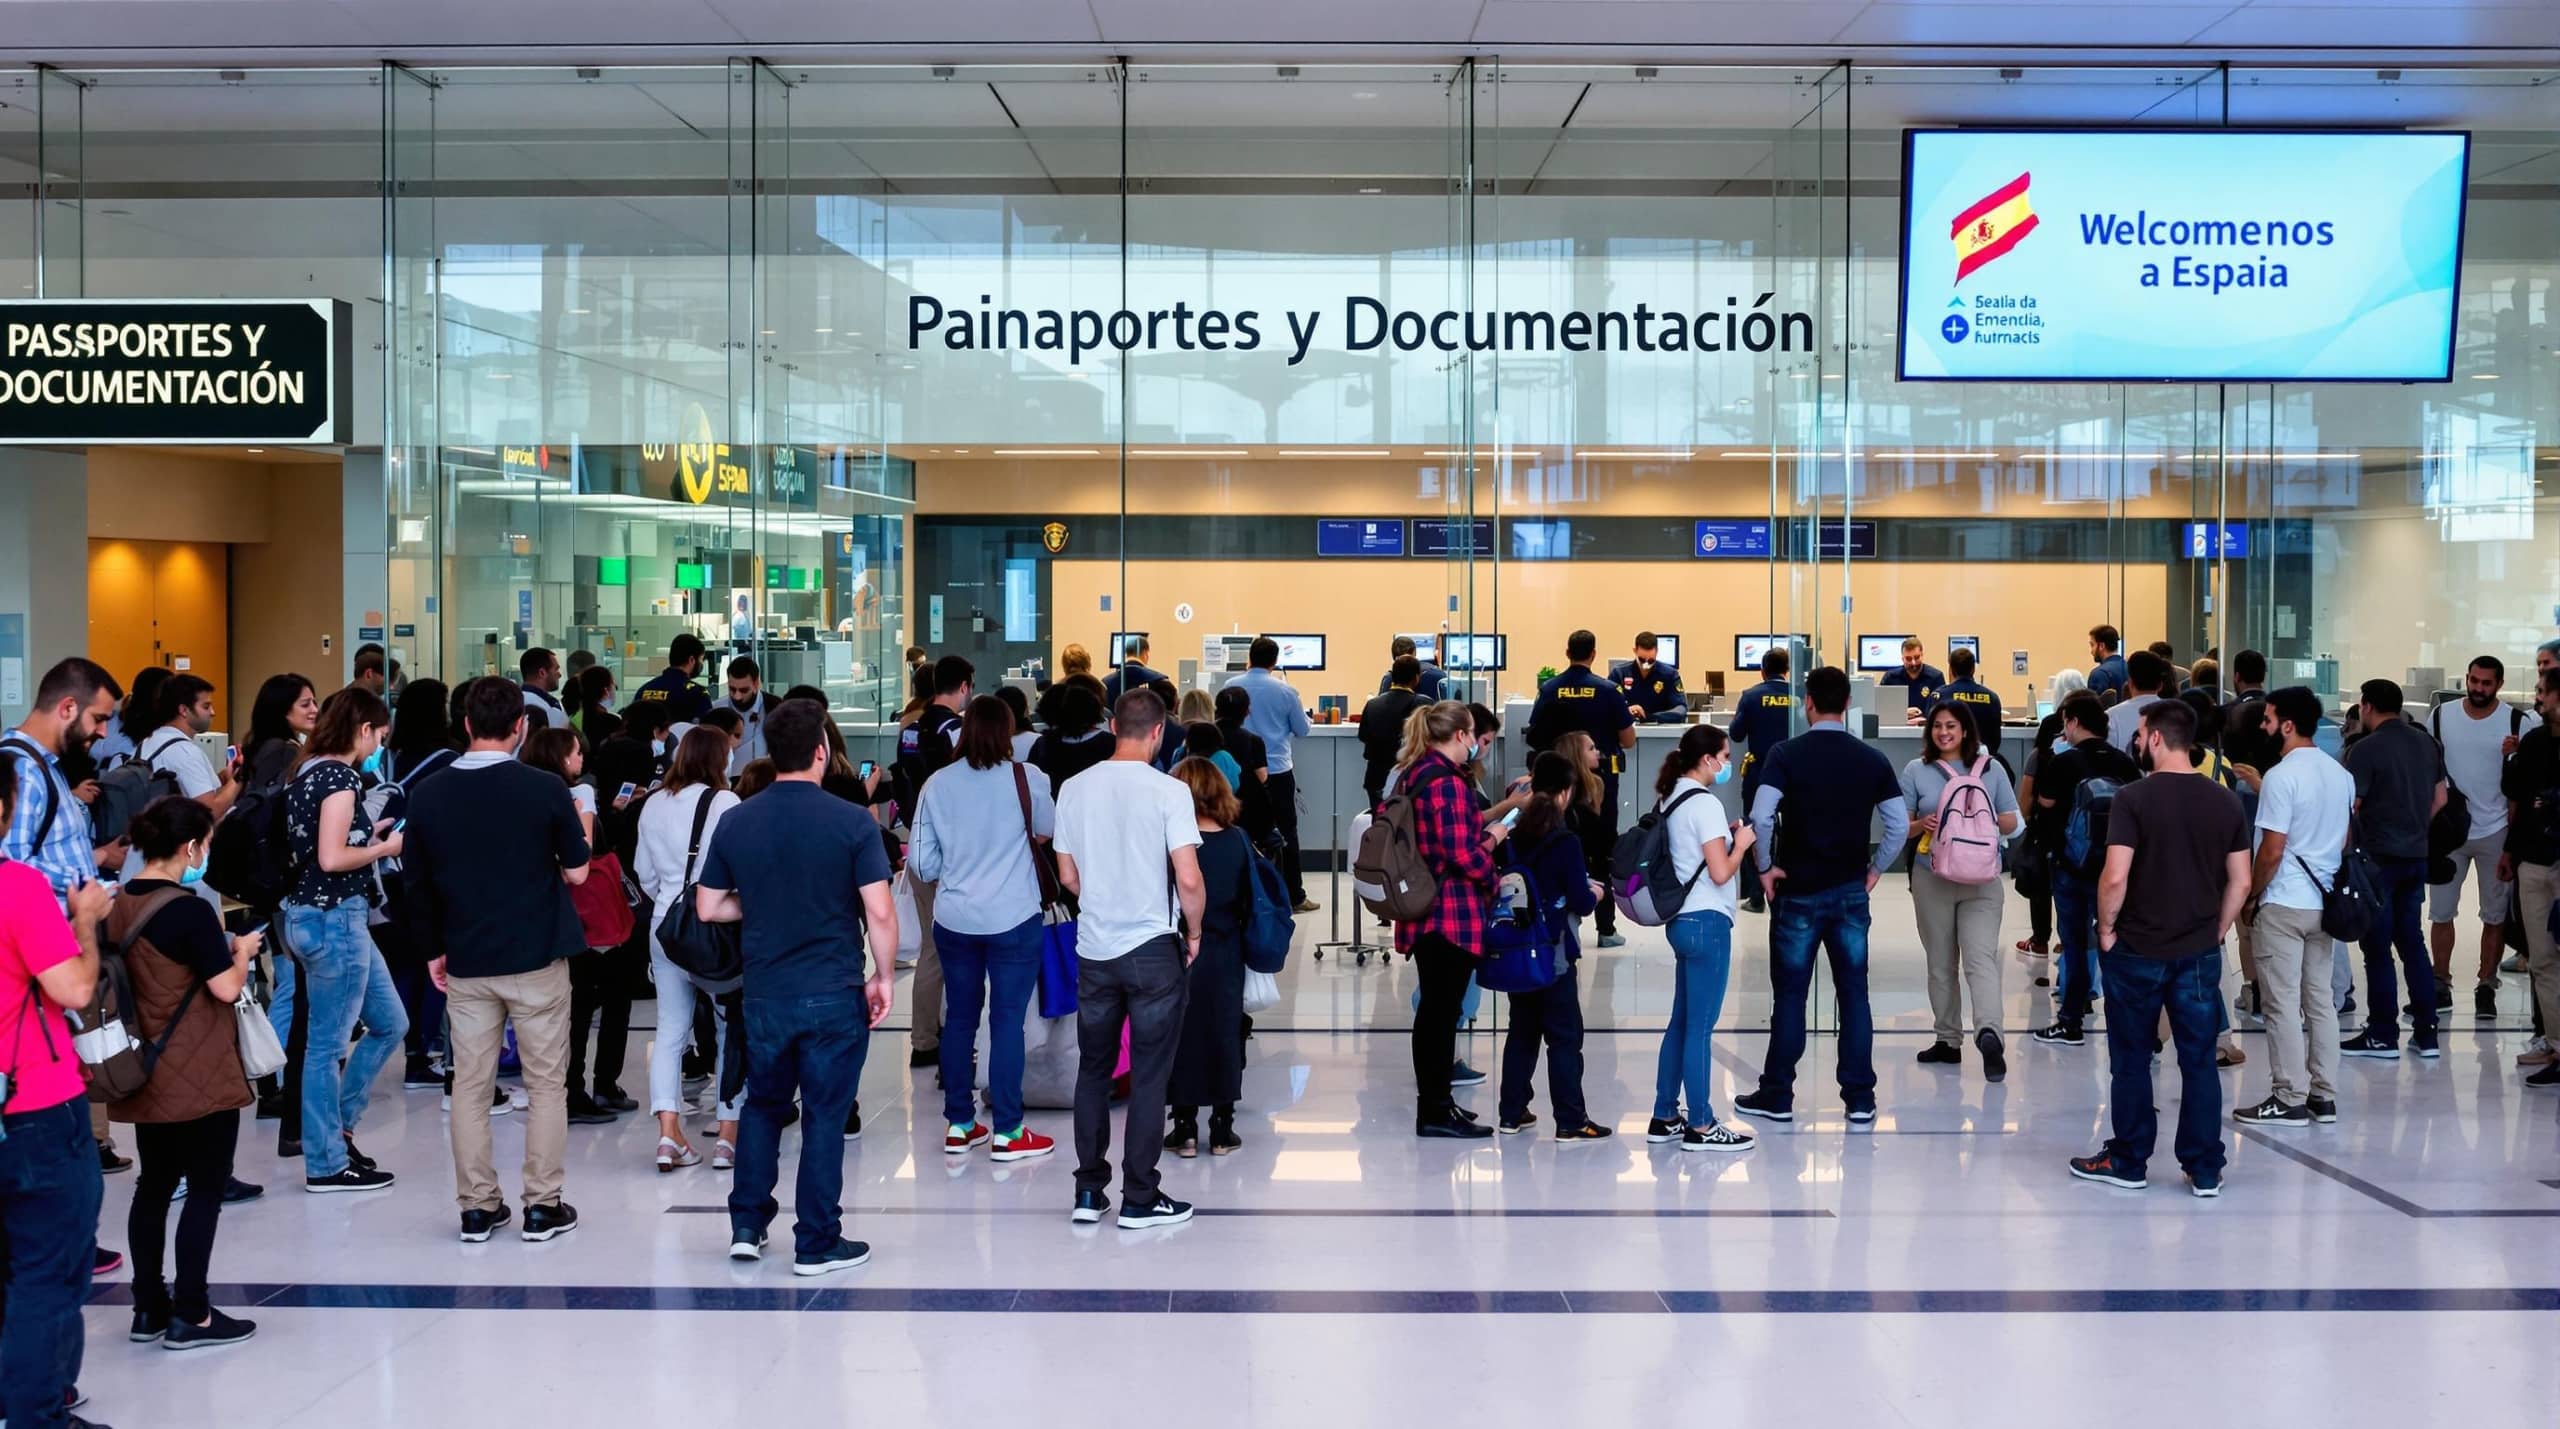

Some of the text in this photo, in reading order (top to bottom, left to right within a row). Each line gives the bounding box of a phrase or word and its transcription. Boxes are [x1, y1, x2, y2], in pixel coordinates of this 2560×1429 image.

[2140, 255, 2288, 295] a Espaia
[2020, 295, 2037, 308] da
[241, 324, 266, 357] Y
[908, 292, 1814, 366] Painaportes y Documentación
[0, 360, 304, 404] DOCUMENTACIÓN
